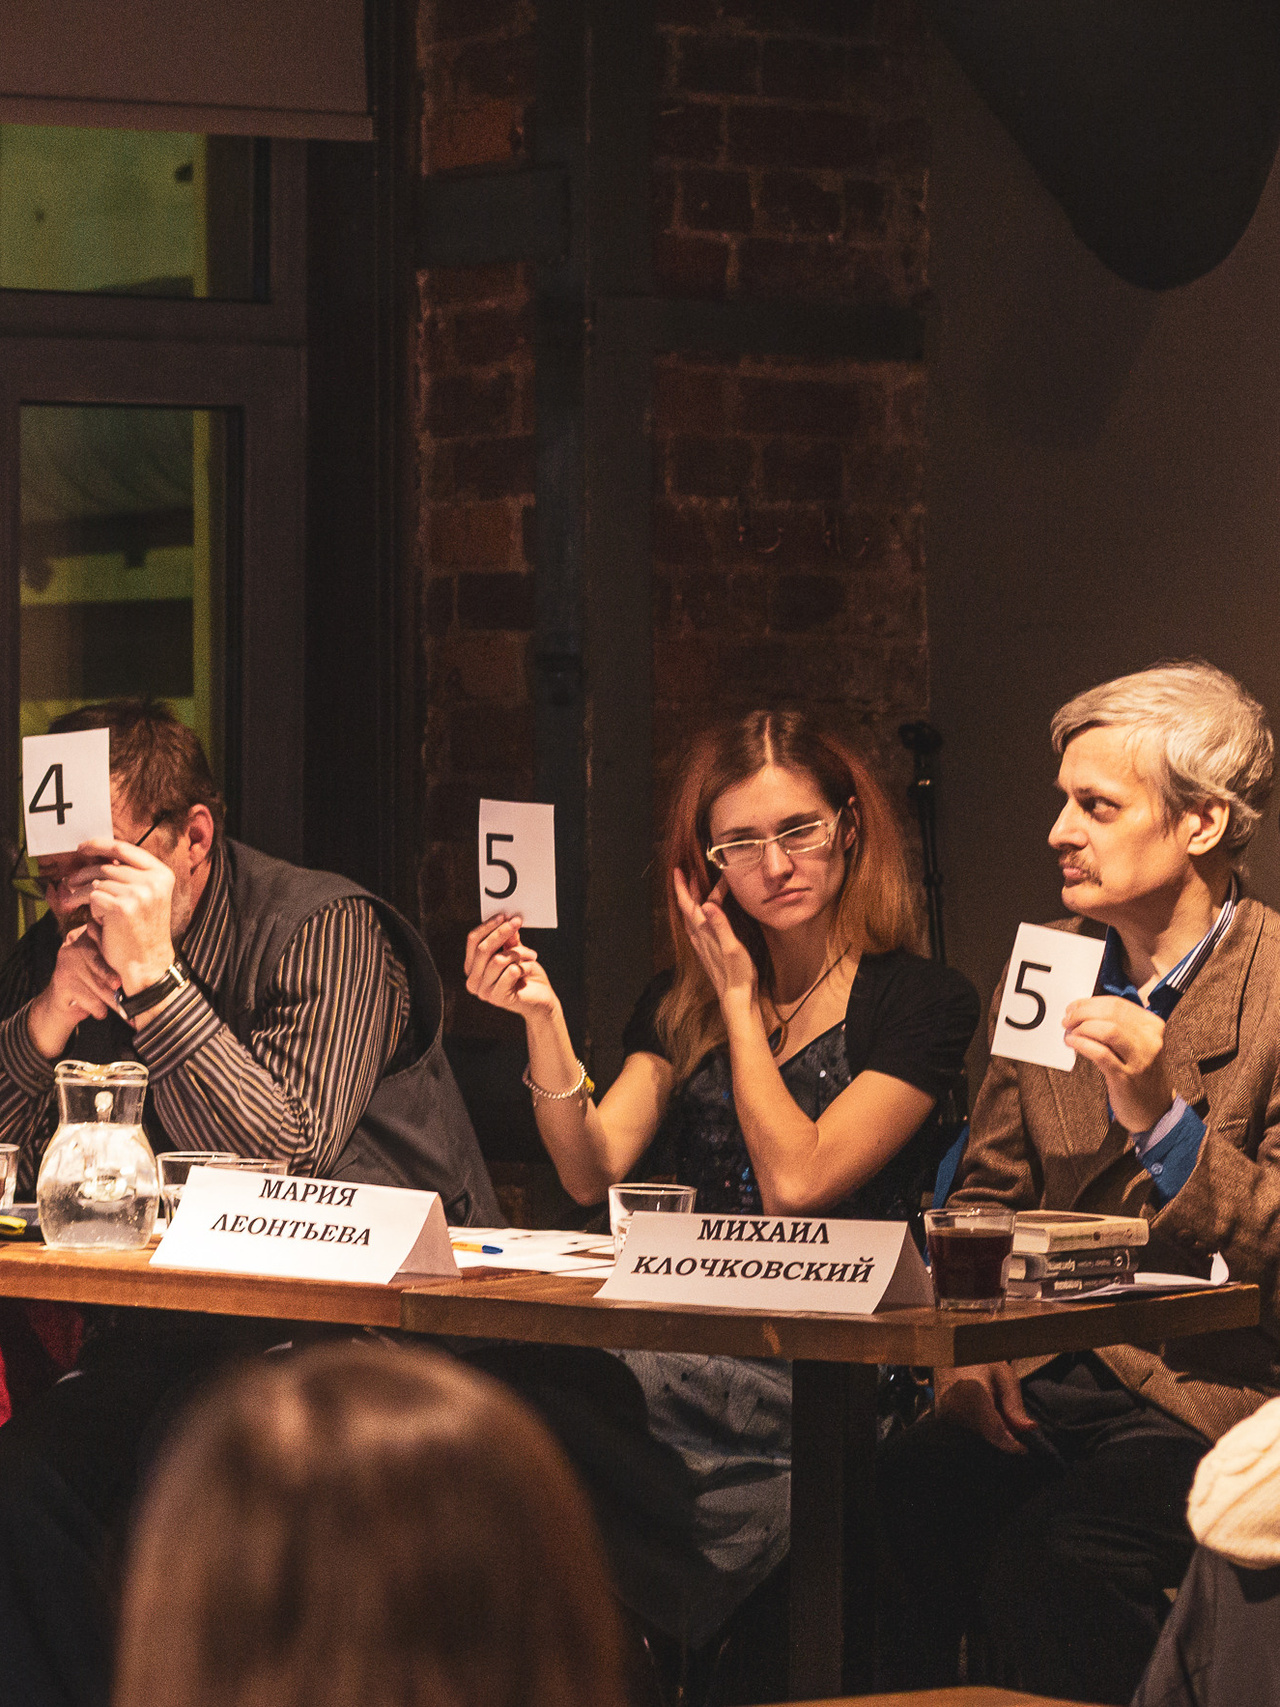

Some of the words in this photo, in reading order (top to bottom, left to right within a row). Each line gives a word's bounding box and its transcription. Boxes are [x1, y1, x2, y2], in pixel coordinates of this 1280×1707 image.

[28, 763, 73, 825] 4
[484, 832, 518, 899] 5
[1005, 960, 1052, 1030] 5
[258, 1178, 359, 1208] МАРИЯ
[210, 1213, 372, 1247] ЛЕОНТЬЕВА
[697, 1219, 830, 1245] МИХАИЛ
[631, 1256, 875, 1283] КЛОЧКОВСКИЙ
